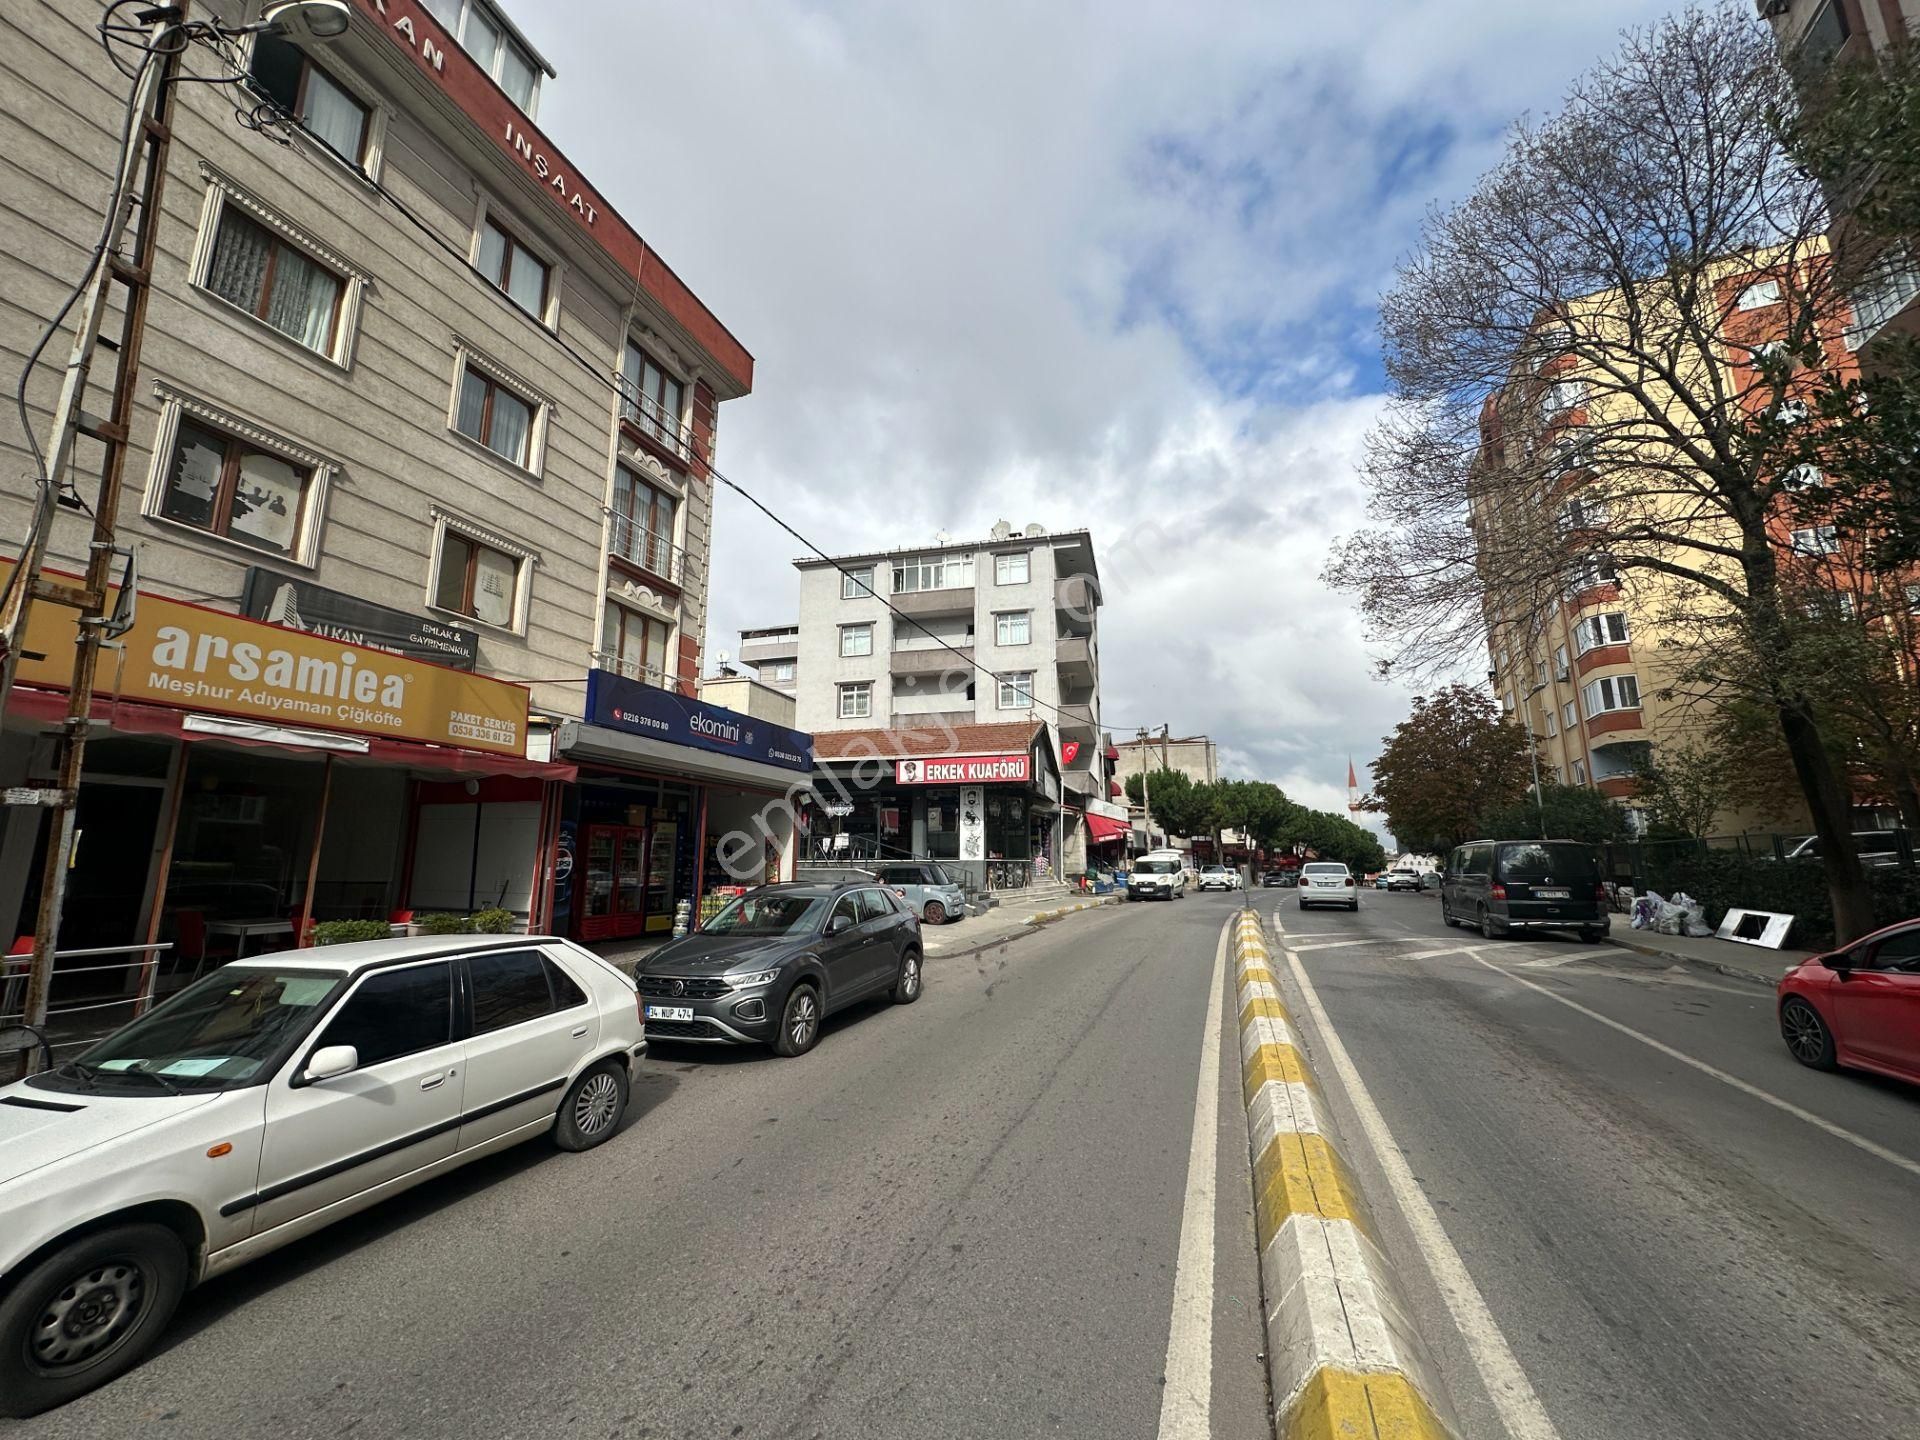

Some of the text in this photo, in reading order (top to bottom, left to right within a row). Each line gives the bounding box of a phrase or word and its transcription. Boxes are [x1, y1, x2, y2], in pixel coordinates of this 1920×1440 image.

[370, 0, 443, 71] AN
[422, 624, 461, 642] EMLAK &
[152, 626, 404, 709] arsamiea
[148, 671, 403, 728] Meşhur Adıyaman Çiğköfte
[450, 711, 516, 731] PAKET SERVİS
[623, 712, 669, 730] 0216 378 00 80
[689, 712, 740, 742] ekomini
[452, 724, 512, 743] 0538 336 61 22
[926, 759, 1025, 780] ERKEK KUAFÖRÜ
[650, 1007, 658, 1017] 34
[677, 1009, 691, 1019] 474
